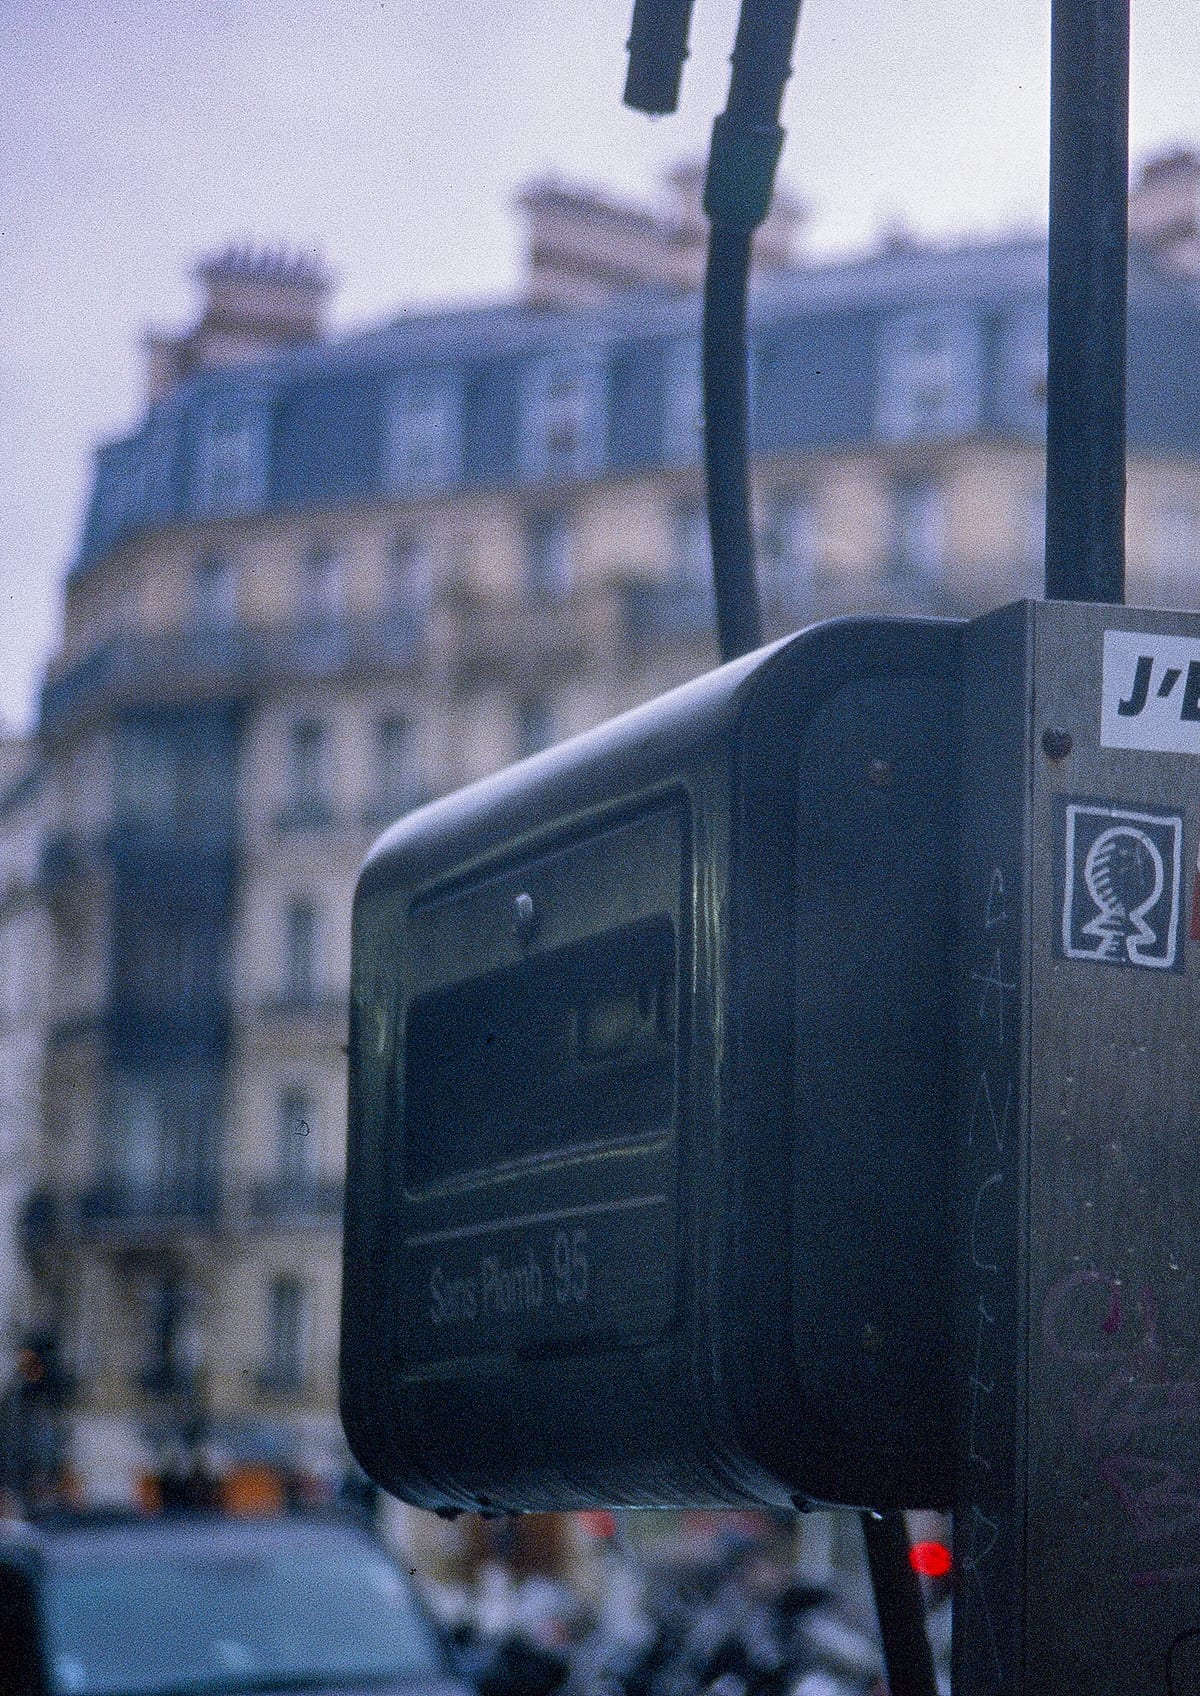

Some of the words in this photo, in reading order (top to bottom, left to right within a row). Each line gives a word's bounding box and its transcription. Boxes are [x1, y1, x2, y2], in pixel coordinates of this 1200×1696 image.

[429, 1265, 478, 1326] Sans
[481, 1247, 544, 1314] Plumb
[553, 1227, 591, 1305] 95
